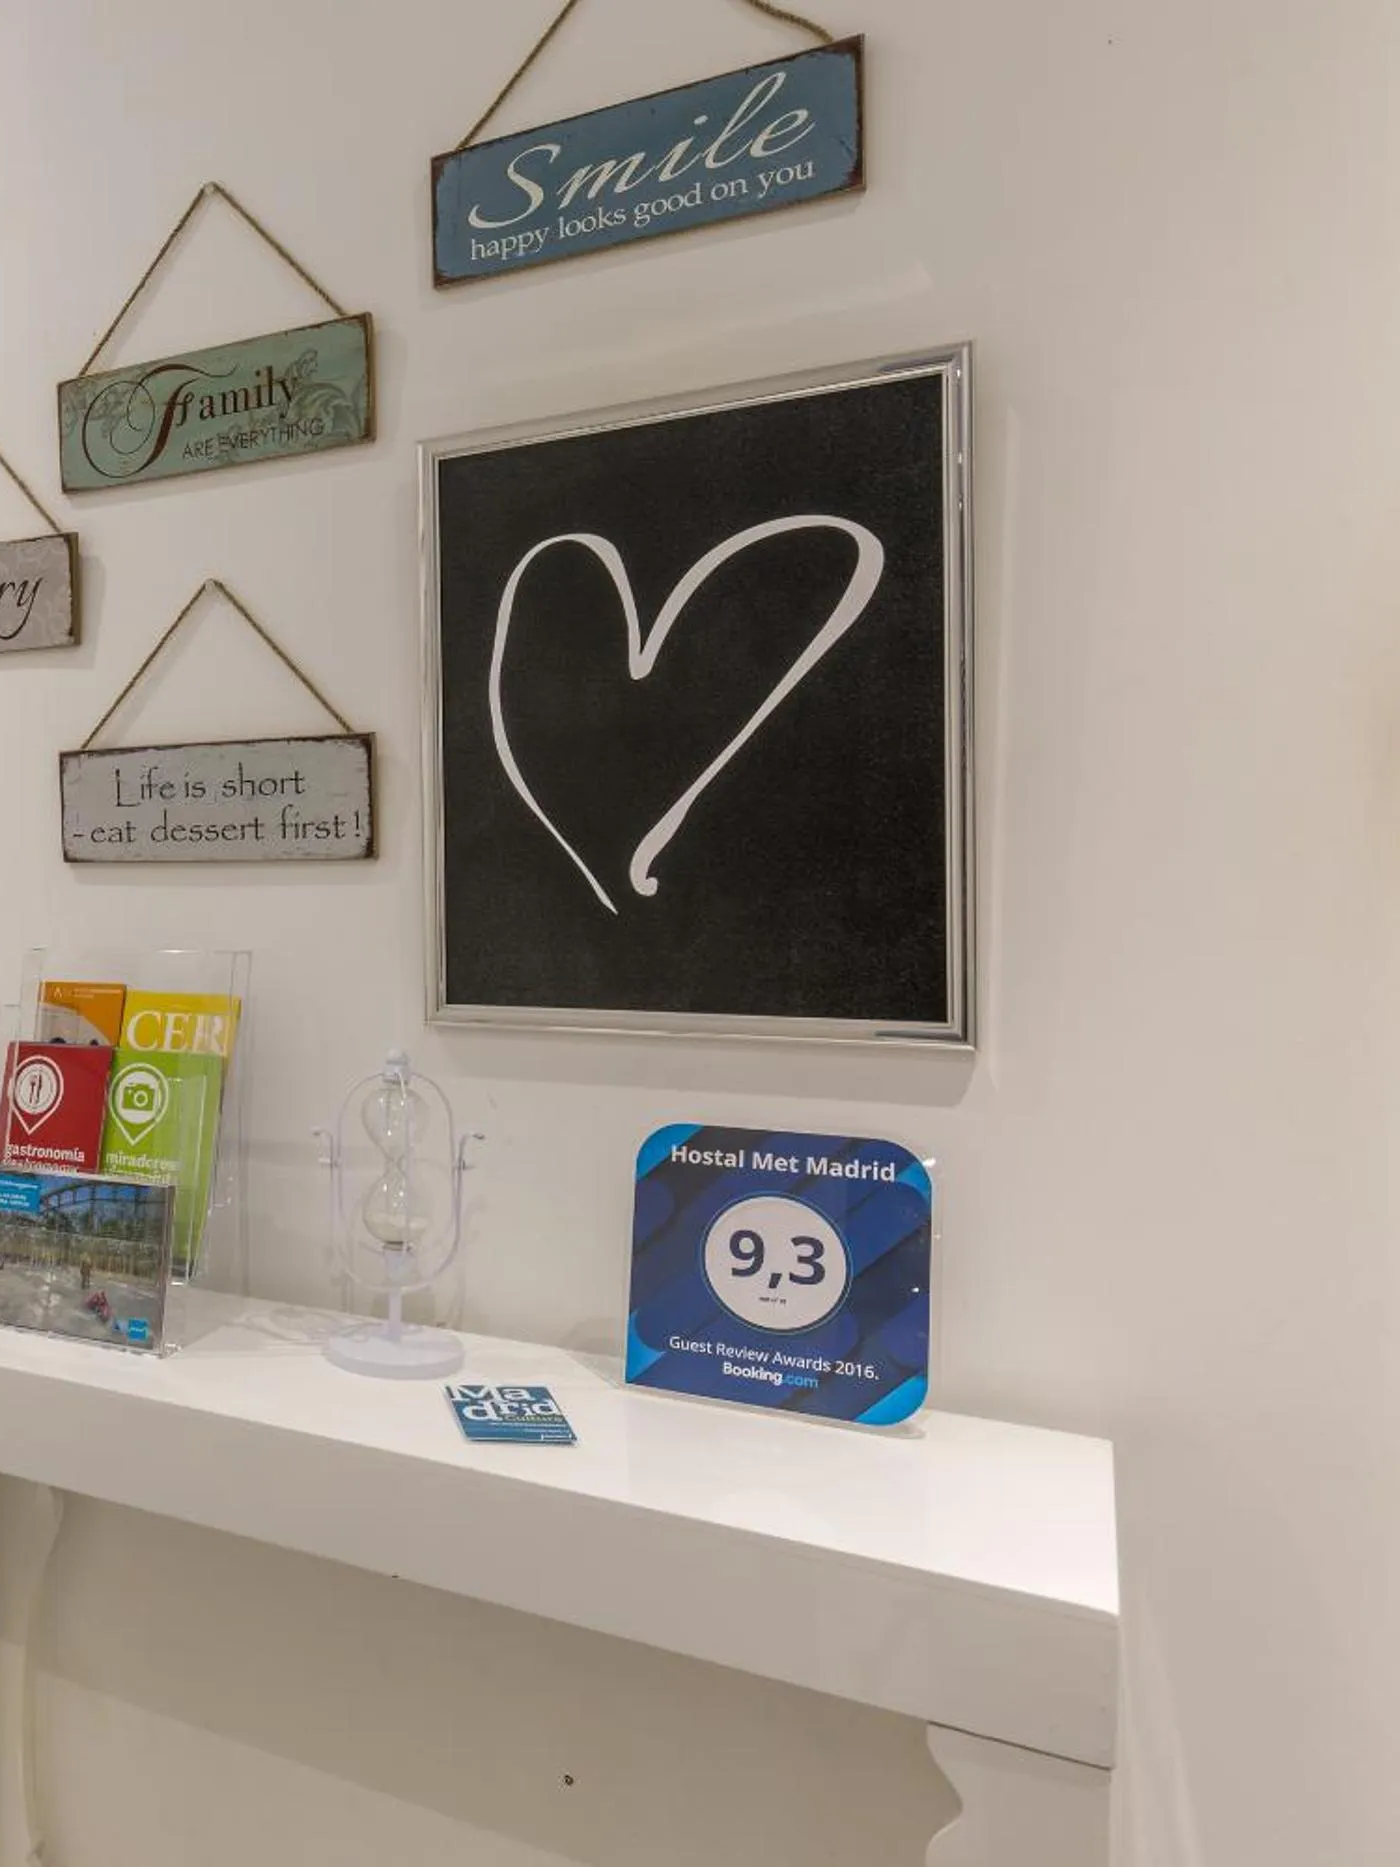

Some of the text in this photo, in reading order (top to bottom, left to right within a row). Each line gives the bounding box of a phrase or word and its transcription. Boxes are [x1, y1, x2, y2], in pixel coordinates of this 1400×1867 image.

[467, 71, 815, 229] Smile
[470, 161, 814, 261] happy looks good on you
[81, 363, 302, 479] Family
[181, 417, 325, 460] ARE EVERYTHING
[113, 762, 305, 807] Life is short
[149, 808, 266, 843] dessert
[5, 1143, 86, 1164] gastronomía
[670, 1145, 896, 1182] Hostal Met Madrid
[728, 1229, 827, 1290] 9,3
[669, 1336, 713, 1354] Guest
[716, 1342, 769, 1363] Review
[772, 1351, 832, 1374] Awards
